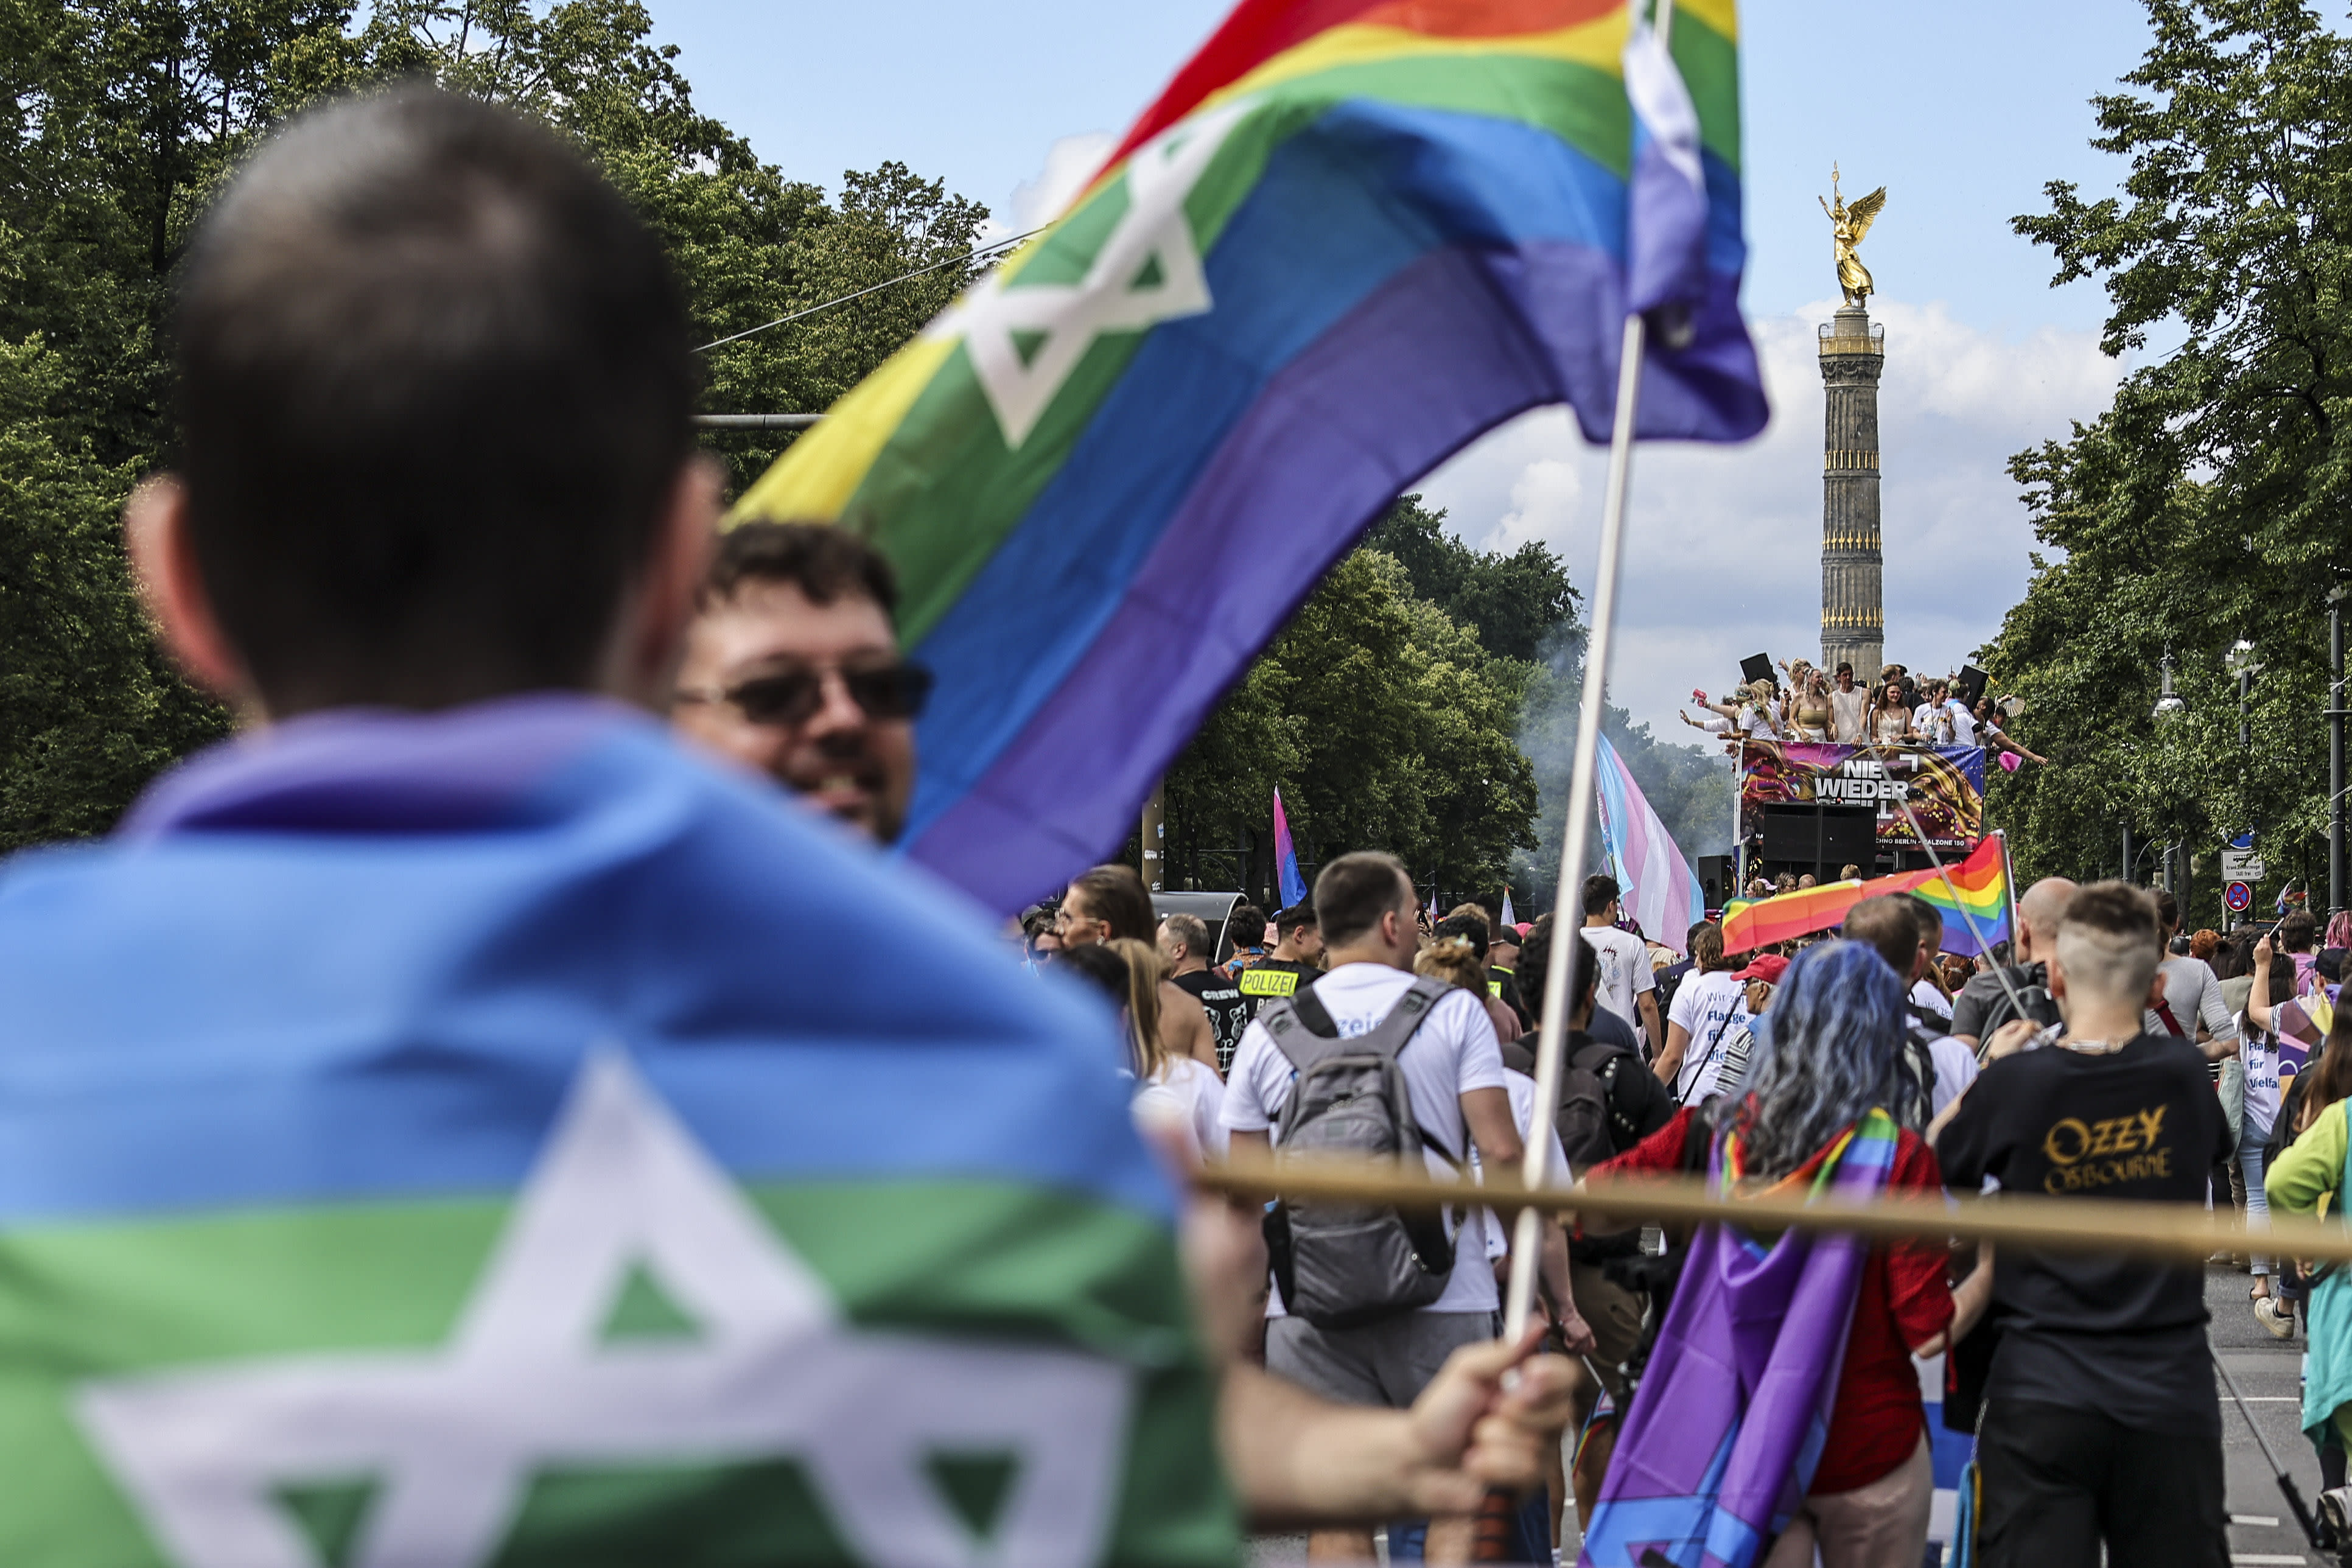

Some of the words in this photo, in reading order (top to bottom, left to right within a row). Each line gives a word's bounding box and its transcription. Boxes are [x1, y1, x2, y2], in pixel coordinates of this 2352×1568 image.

[1844, 760, 1882, 779] NIE
[1815, 778, 1909, 800] WIEDER
[1242, 973, 1294, 993] POLIZEI
[1202, 989, 1240, 1001] CREW
[1707, 991, 1725, 1003] Wir
[2249, 1058, 2264, 1070] für
[2042, 1105, 2167, 1165] OZZY
[2044, 1147, 2172, 1194] OSBOURNE
